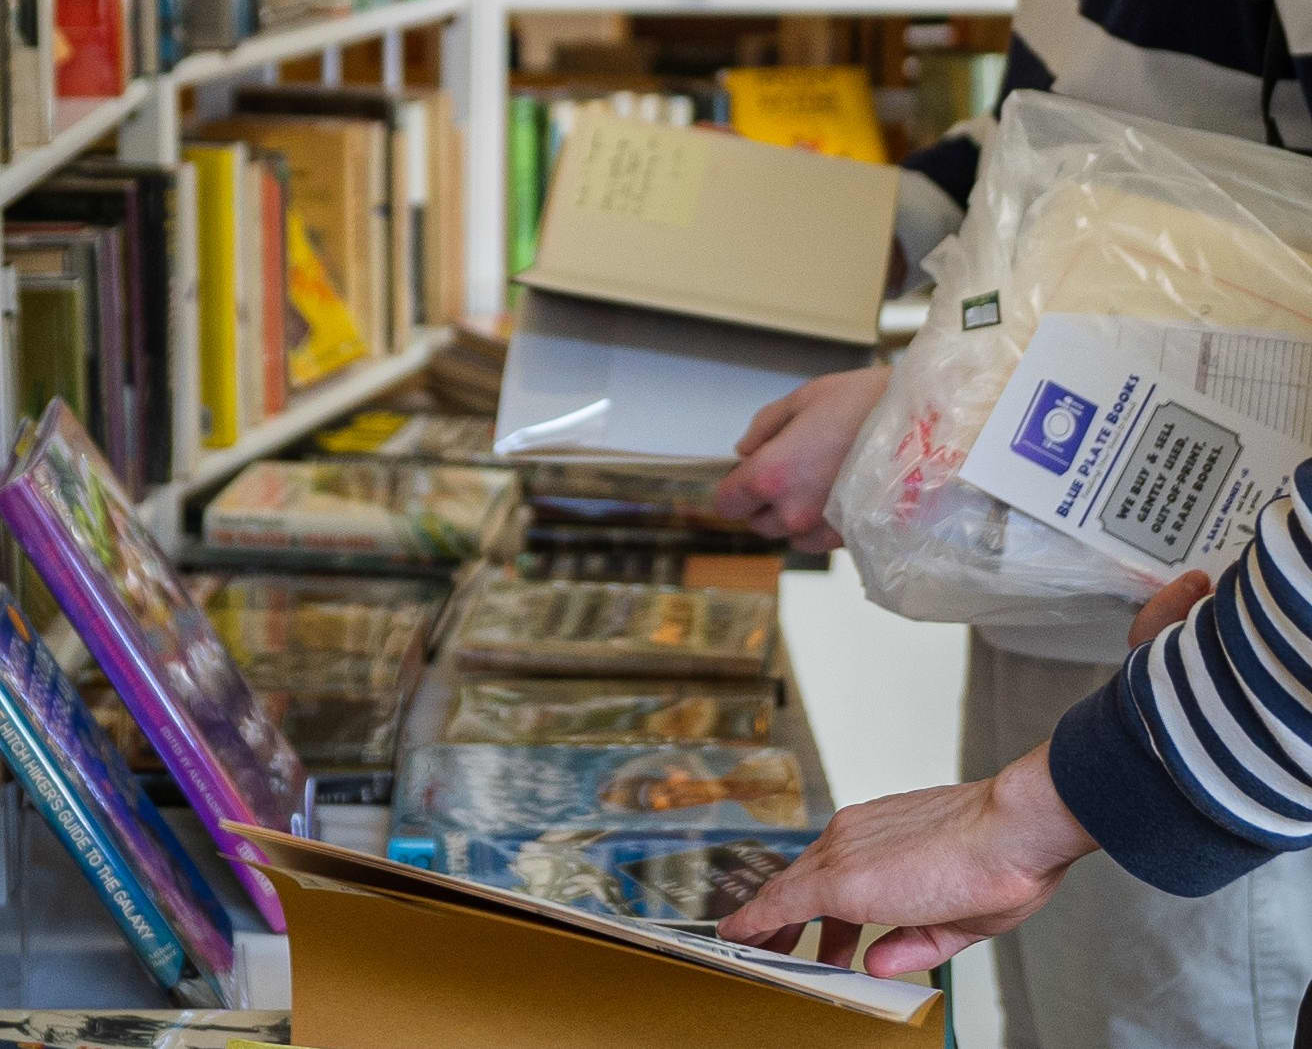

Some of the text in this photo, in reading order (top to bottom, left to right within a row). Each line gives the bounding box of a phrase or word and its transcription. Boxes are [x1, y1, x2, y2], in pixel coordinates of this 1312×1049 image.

[1055, 478, 1084, 519] BLUE
[1077, 426, 1113, 477] PLATE
[1105, 373, 1141, 425] BOOKS
[1116, 422, 1175, 519] WE BUY & SELL
[1137, 472, 1167, 523] GENTLY
[1163, 533, 1177, 546] &
[1171, 493, 1197, 532] RARE
[23, 759, 65, 812] HIKER'S
[58, 809, 92, 851] GUIDE
[85, 846, 102, 867] TO
[96, 864, 121, 894] THE
[113, 890, 156, 941] GALAXY
